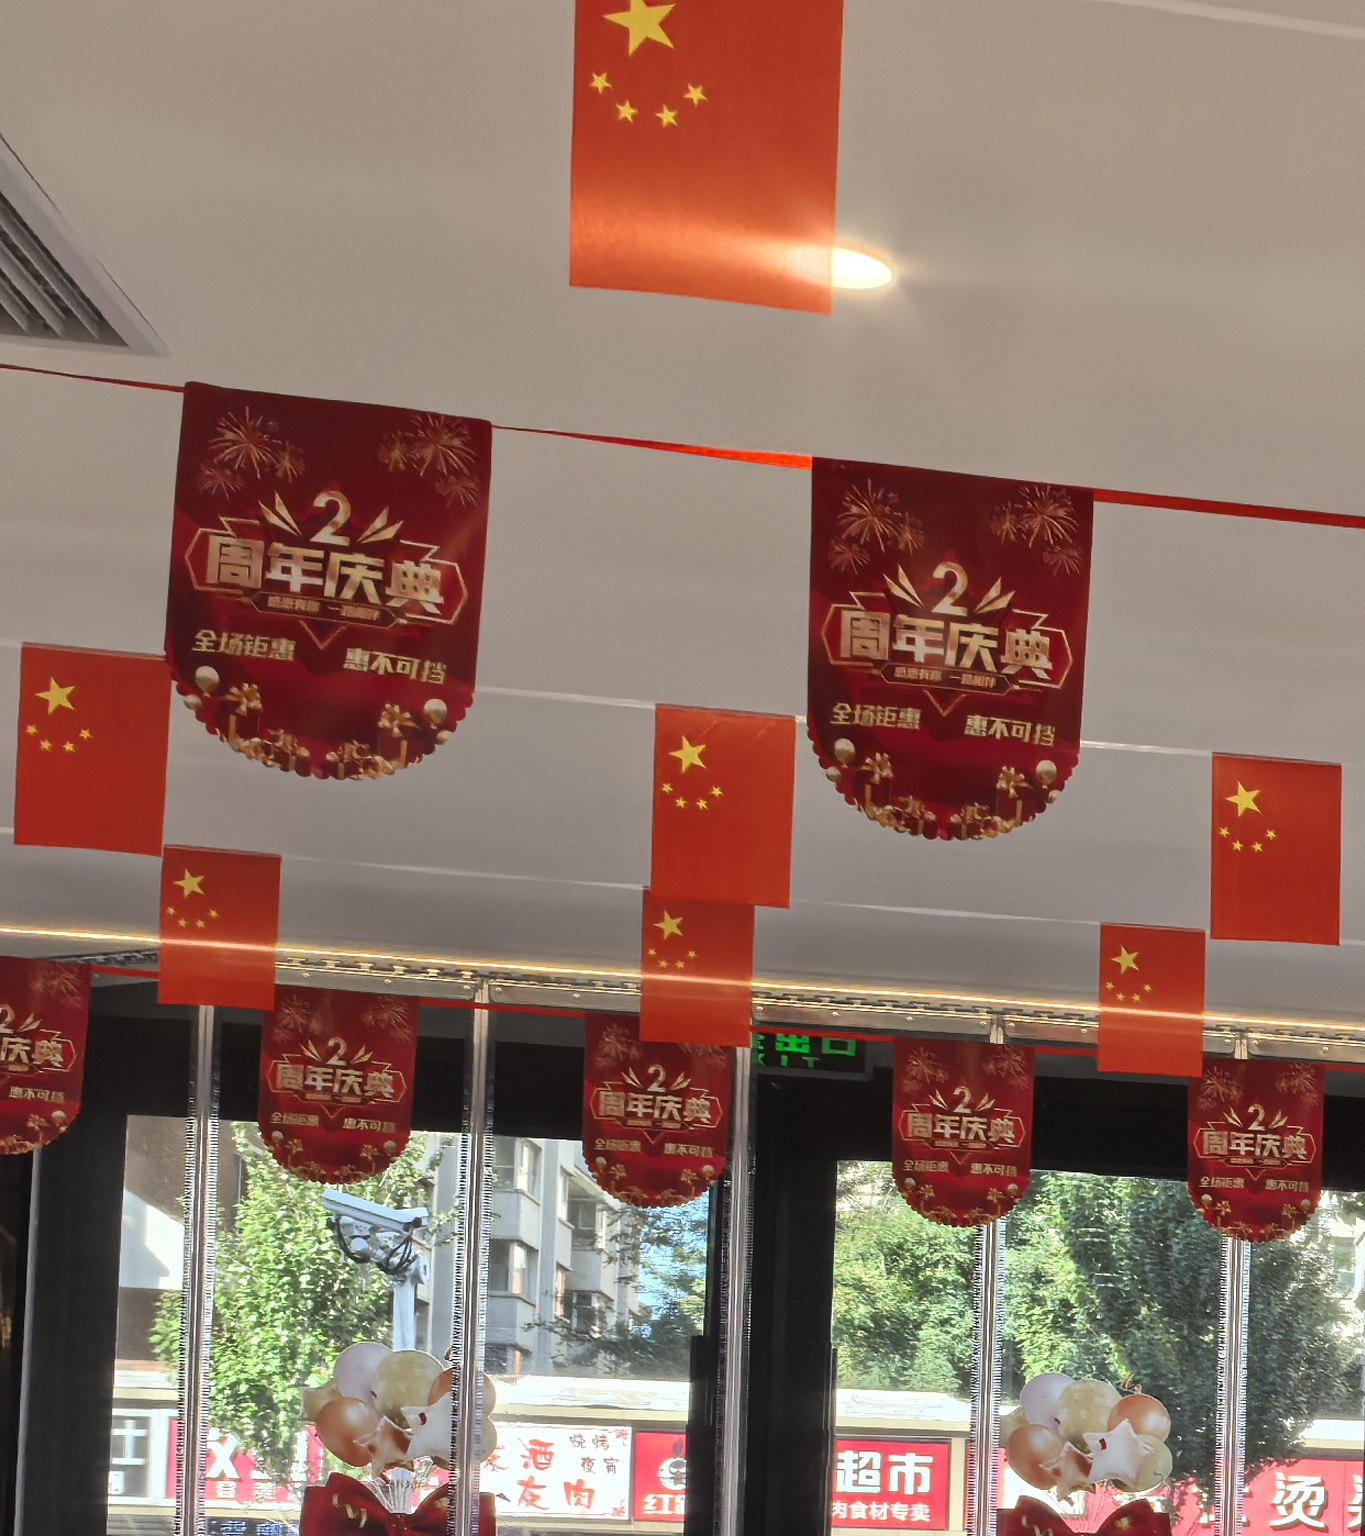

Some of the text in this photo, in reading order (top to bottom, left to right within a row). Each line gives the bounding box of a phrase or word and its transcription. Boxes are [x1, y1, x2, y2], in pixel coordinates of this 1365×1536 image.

[310, 491, 351, 546] 2
[206, 535, 445, 615] 周年庆典
[931, 561, 968, 616] 2
[840, 610, 1053, 680] 周年庆典
[327, 1037, 348, 1065] 2
[276, 1063, 395, 1099] 周年庆典
[647, 1065, 667, 1093] 2
[598, 1091, 712, 1122] 周年庆典
[953, 1086, 973, 1114] 2
[907, 1112, 1016, 1143] 周年庆典
[1247, 1104, 1266, 1130] 2
[1202, 1130, 1308, 1161] 周年庆典
[569, 1434, 611, 1450] 烧烤
[837, 1450, 933, 1494] 超市
